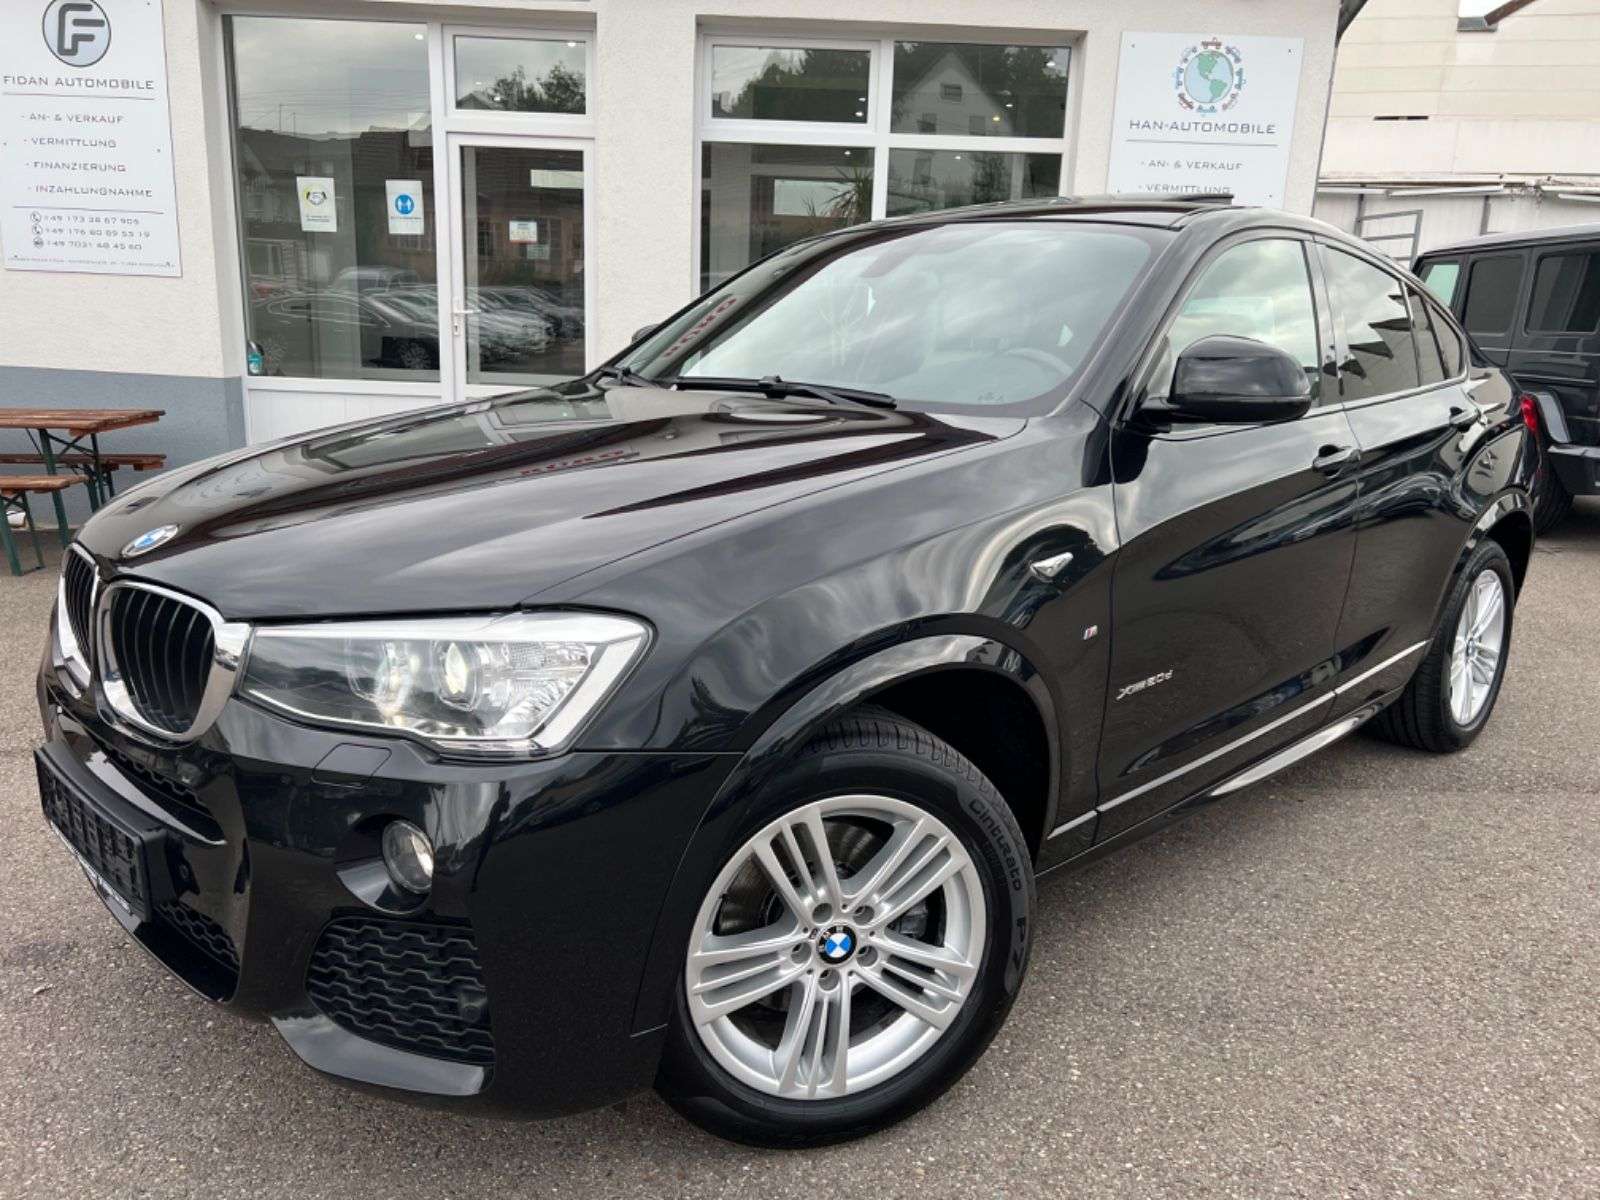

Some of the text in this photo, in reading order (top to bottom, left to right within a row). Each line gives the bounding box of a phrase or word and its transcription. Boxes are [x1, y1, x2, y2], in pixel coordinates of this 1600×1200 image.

[3, 75, 155, 91] FIDAN AUTOMOBILE
[54, 113, 62, 122] &
[67, 114, 125, 125] VERKAUF
[1129, 119, 1277, 135] HAN-AUTOMOBILE
[31, 136, 118, 149] VERMITTLUNG
[33, 160, 127, 173] FINANZIERUNG
[1174, 160, 1182, 169] &
[1186, 160, 1244, 172] VERKAUF
[35, 184, 153, 198] INZAHLUNGNAHME
[1146, 184, 1231, 194] VERMITTLUNG
